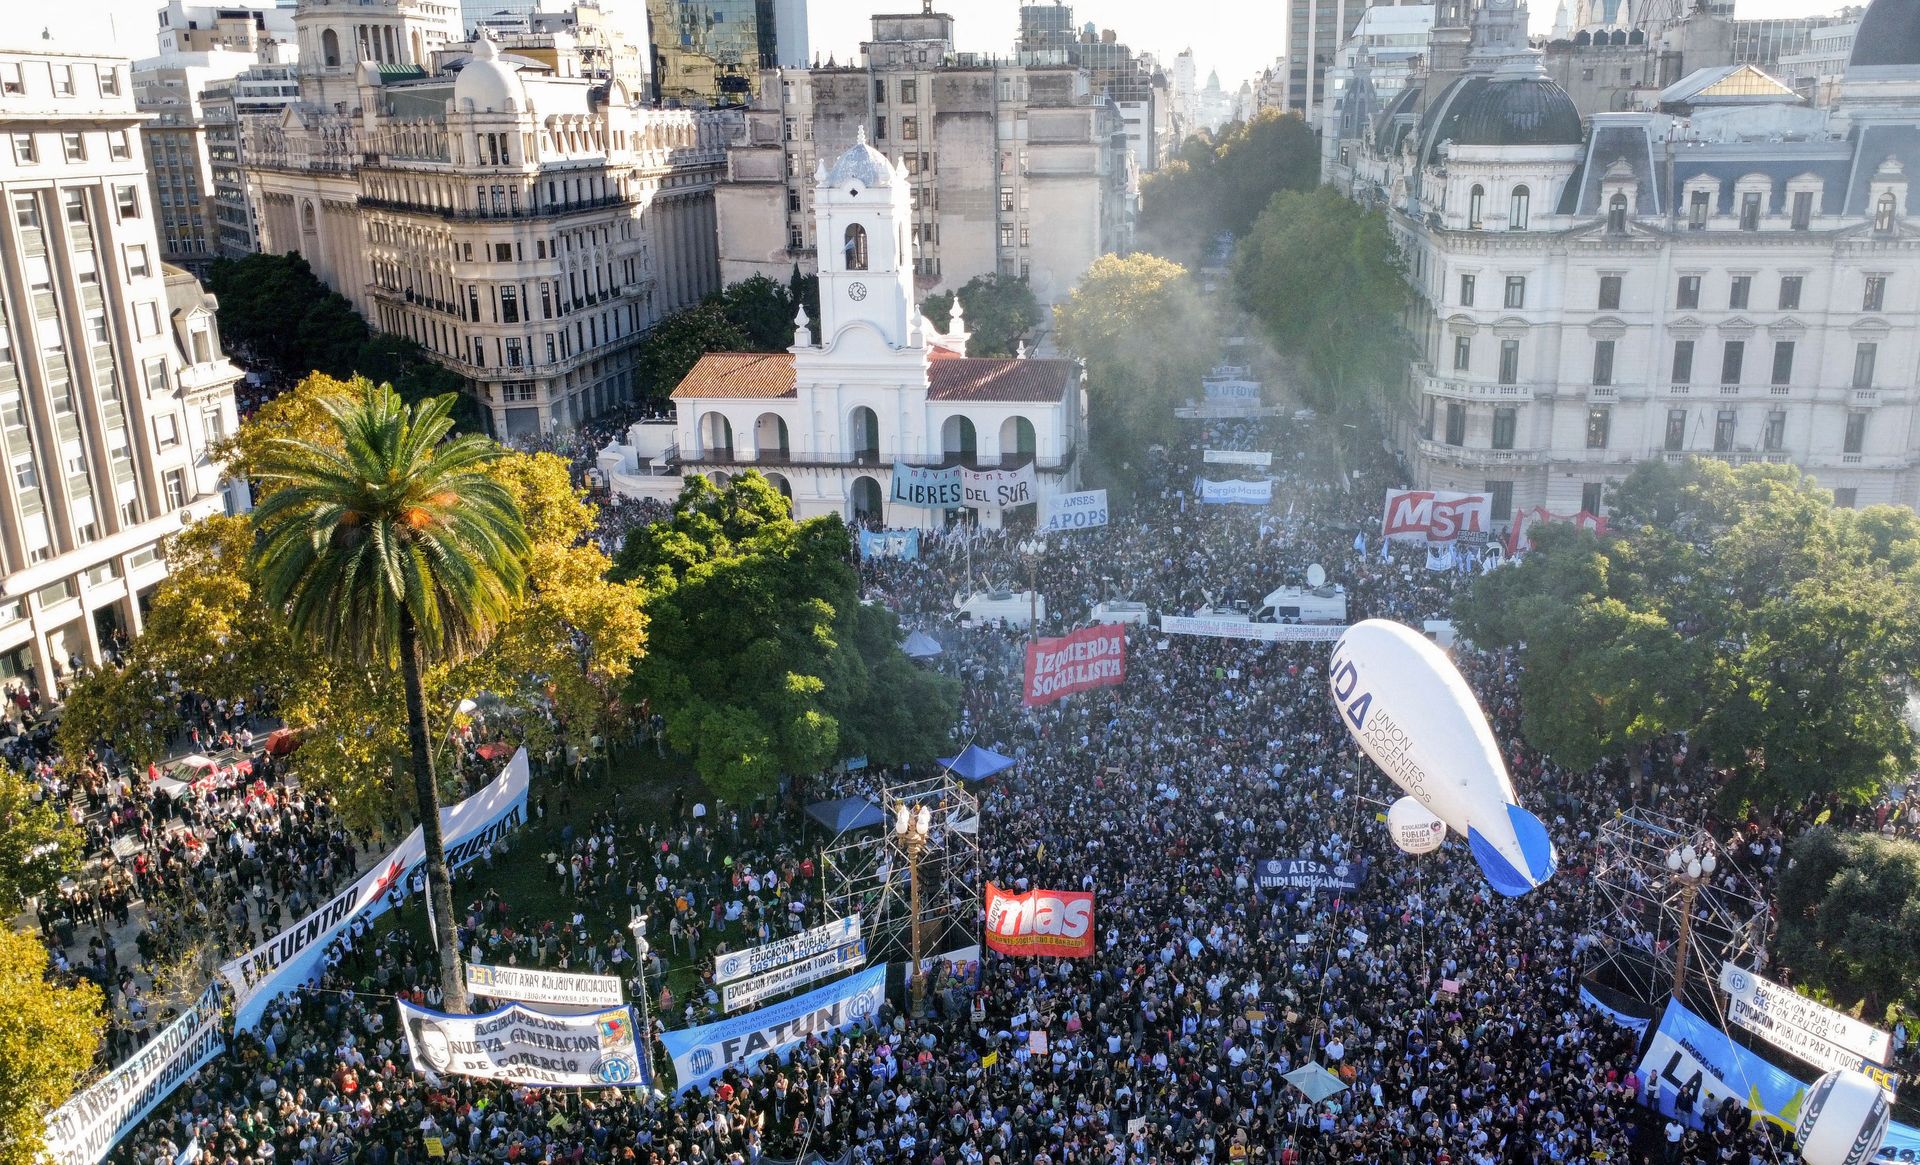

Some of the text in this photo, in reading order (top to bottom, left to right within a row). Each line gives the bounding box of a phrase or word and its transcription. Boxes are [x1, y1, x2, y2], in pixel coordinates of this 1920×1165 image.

[966, 487, 990, 502] DEL
[998, 481, 1029, 506] SUR
[1063, 495, 1095, 508] ANSES
[1207, 486, 1267, 497] Sergio Massa
[1050, 508, 1107, 529] APOPS
[1391, 499, 1483, 538] MST
[1034, 637, 1121, 675] IZQUIERDA
[1032, 659, 1121, 697] SOCIALISTA
[1375, 708, 1413, 750] UNION
[1362, 730, 1432, 803] ARGENTINOS
[1367, 719, 1425, 783] DOCENTES
[1401, 830, 1430, 838] PUBLICA
[988, 897, 1002, 930] nuevo
[1000, 896, 1092, 938] mas
[750, 954, 788, 973] GASTON
[721, 1003, 841, 1063] FATUN
[722, 1029, 737, 1039] LAS
[1752, 996, 1828, 1038] GASTON FRUTOS
[450, 1037, 505, 1056] NUEVA
[691, 1049, 714, 1076] FATUN
[1810, 1037, 1831, 1061] PARA
[119, 1061, 140, 1096] DE
[464, 1061, 489, 1070] DE
[1661, 1050, 1703, 1103] LA
[84, 1084, 156, 1161] MUCHACHOS
